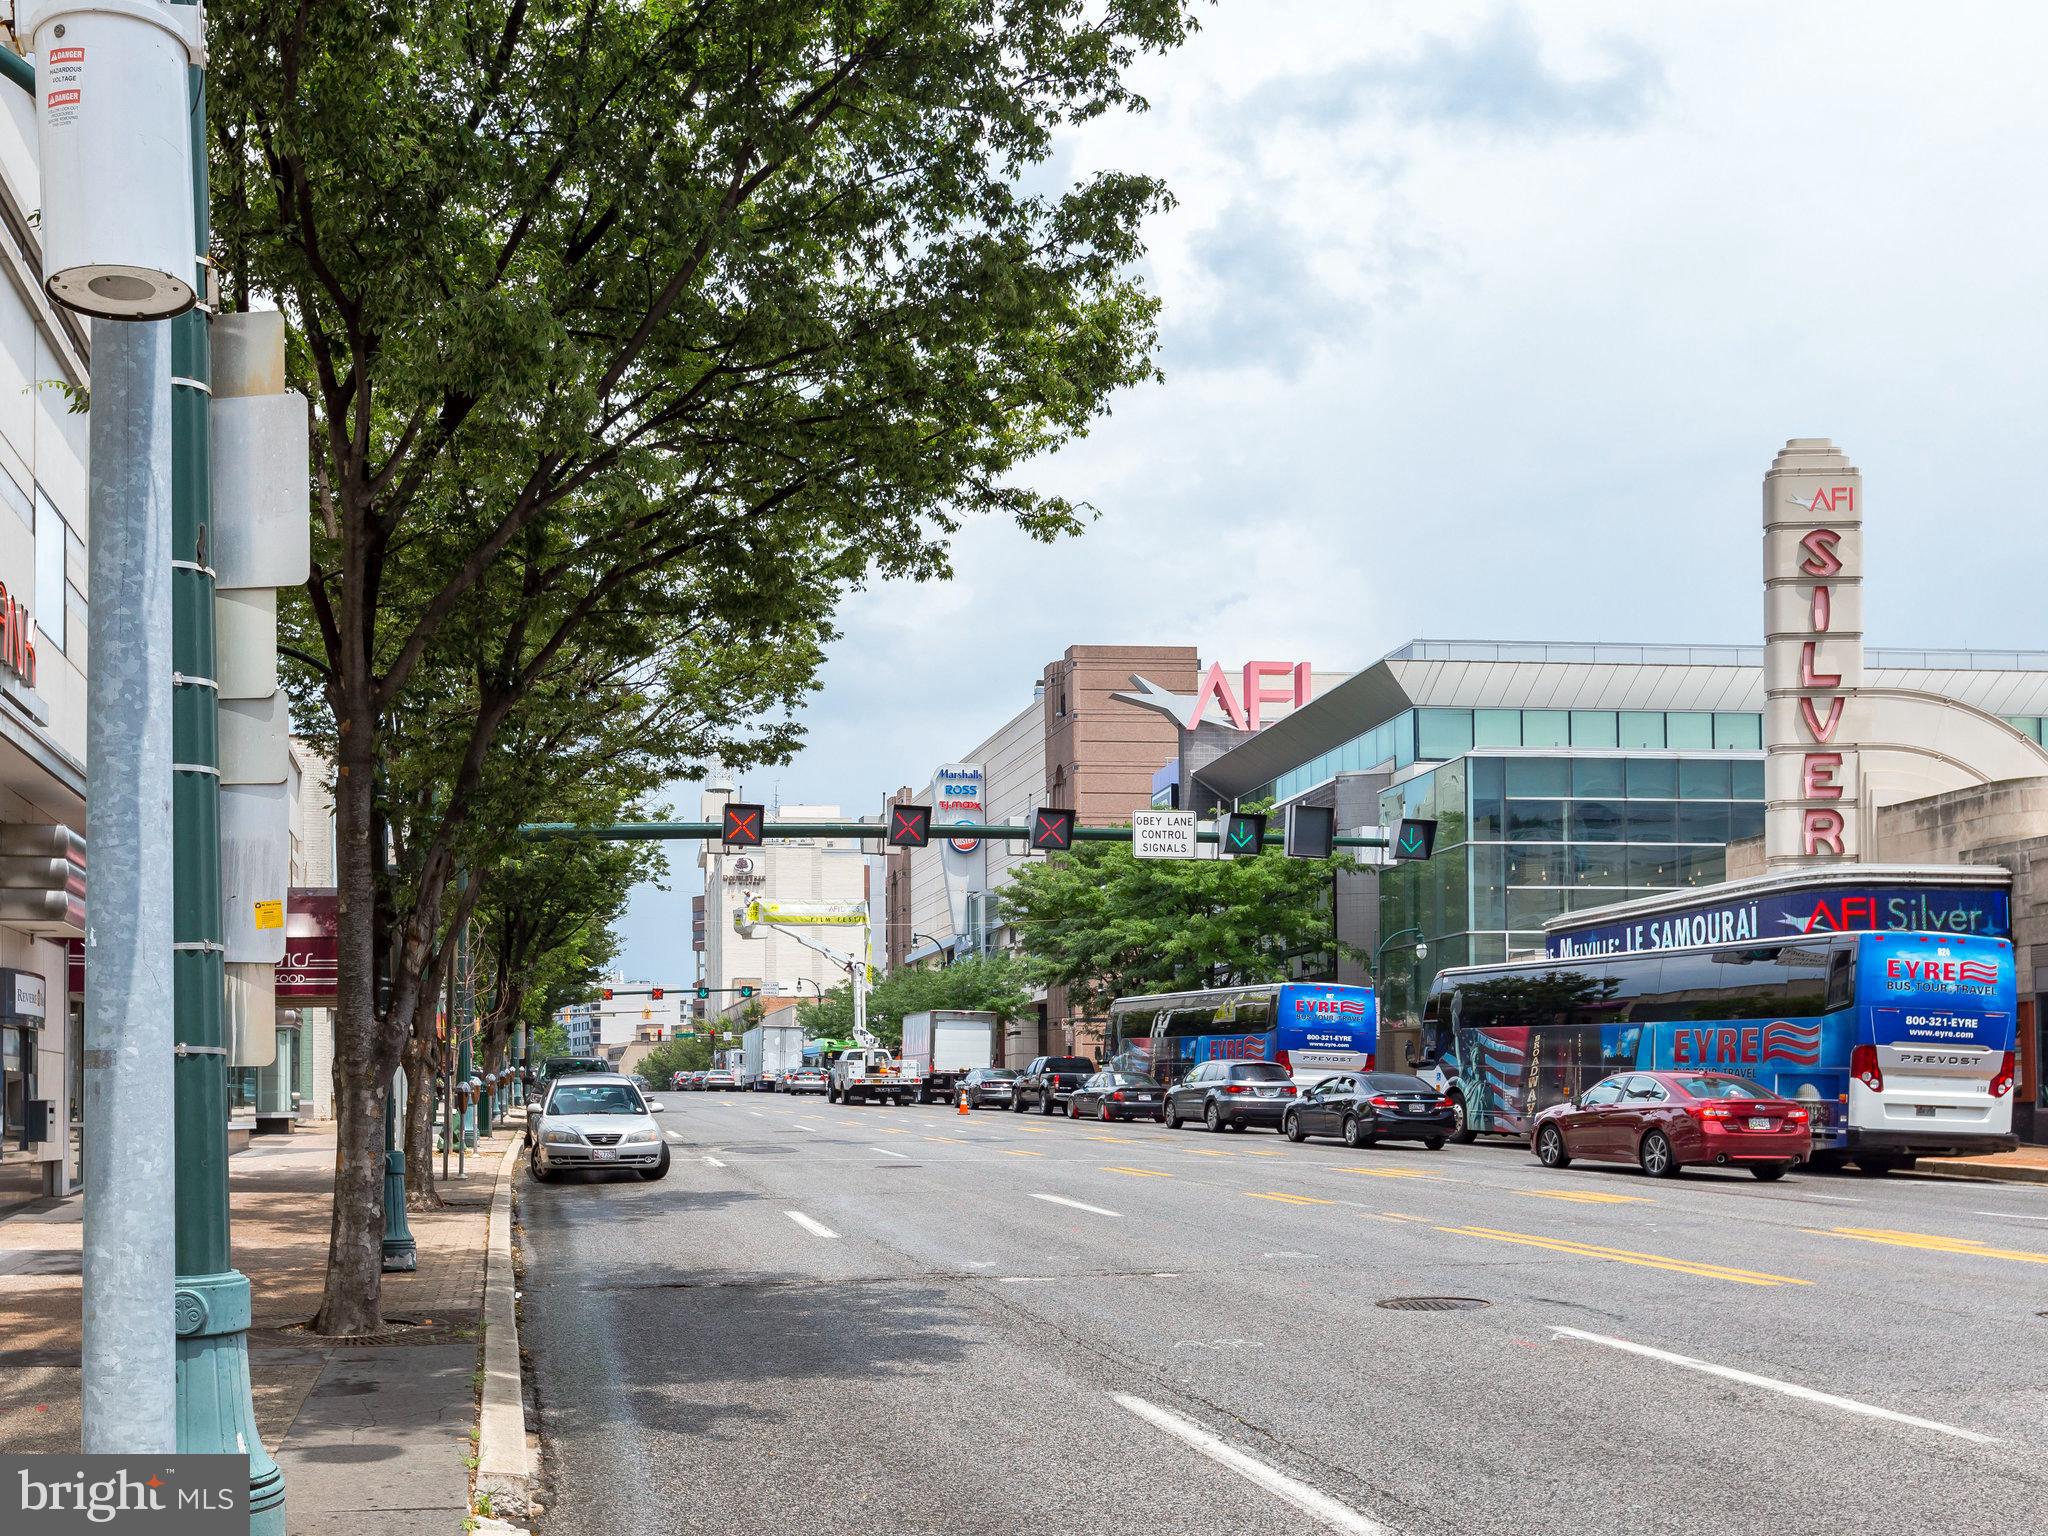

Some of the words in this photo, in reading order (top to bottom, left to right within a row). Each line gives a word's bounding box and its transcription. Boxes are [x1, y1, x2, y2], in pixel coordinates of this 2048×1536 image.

[57, 50, 83, 59] DANGER
[49, 66, 82, 75] HAZARDOUS
[52, 75, 77, 83] VOLTAGE
[55, 92, 79, 102] DANGER
[1810, 487, 1854, 512] AFI
[1186, 661, 1311, 731] AFI
[1799, 528, 1845, 856] SILVER
[936, 768, 983, 780] Marshalls
[944, 784, 978, 796] ROSS
[1136, 816, 1162, 826] OBEY
[1167, 817, 1193, 827] LANE
[1141, 829, 1188, 840] CONTROL
[1142, 842, 1187, 853] SIGNALS
[1803, 897, 1877, 933] AFI
[1887, 894, 1983, 931] Silver
[1626, 925, 1644, 952] LE
[1887, 959, 1956, 982] EYRE
[275, 974, 305, 983] FOOD
[1915, 982, 1948, 993] TOUR
[1955, 984, 1997, 996] TRAVEL
[1295, 999, 1339, 1013] EYRE
[1905, 1015, 1979, 1029] 800-321-EYRE
[1306, 1033, 1353, 1042] 800-321-EYRE
[1909, 1028, 1974, 1039] www.eyre.com
[1210, 1039, 1243, 1061] EYRE
[1674, 1027, 1759, 1064] EYRE
[1302, 1055, 1353, 1063] PREVOST
[1900, 1054, 1982, 1066] PREVOST
[1526, 1034, 1541, 1118] BROADWAY
